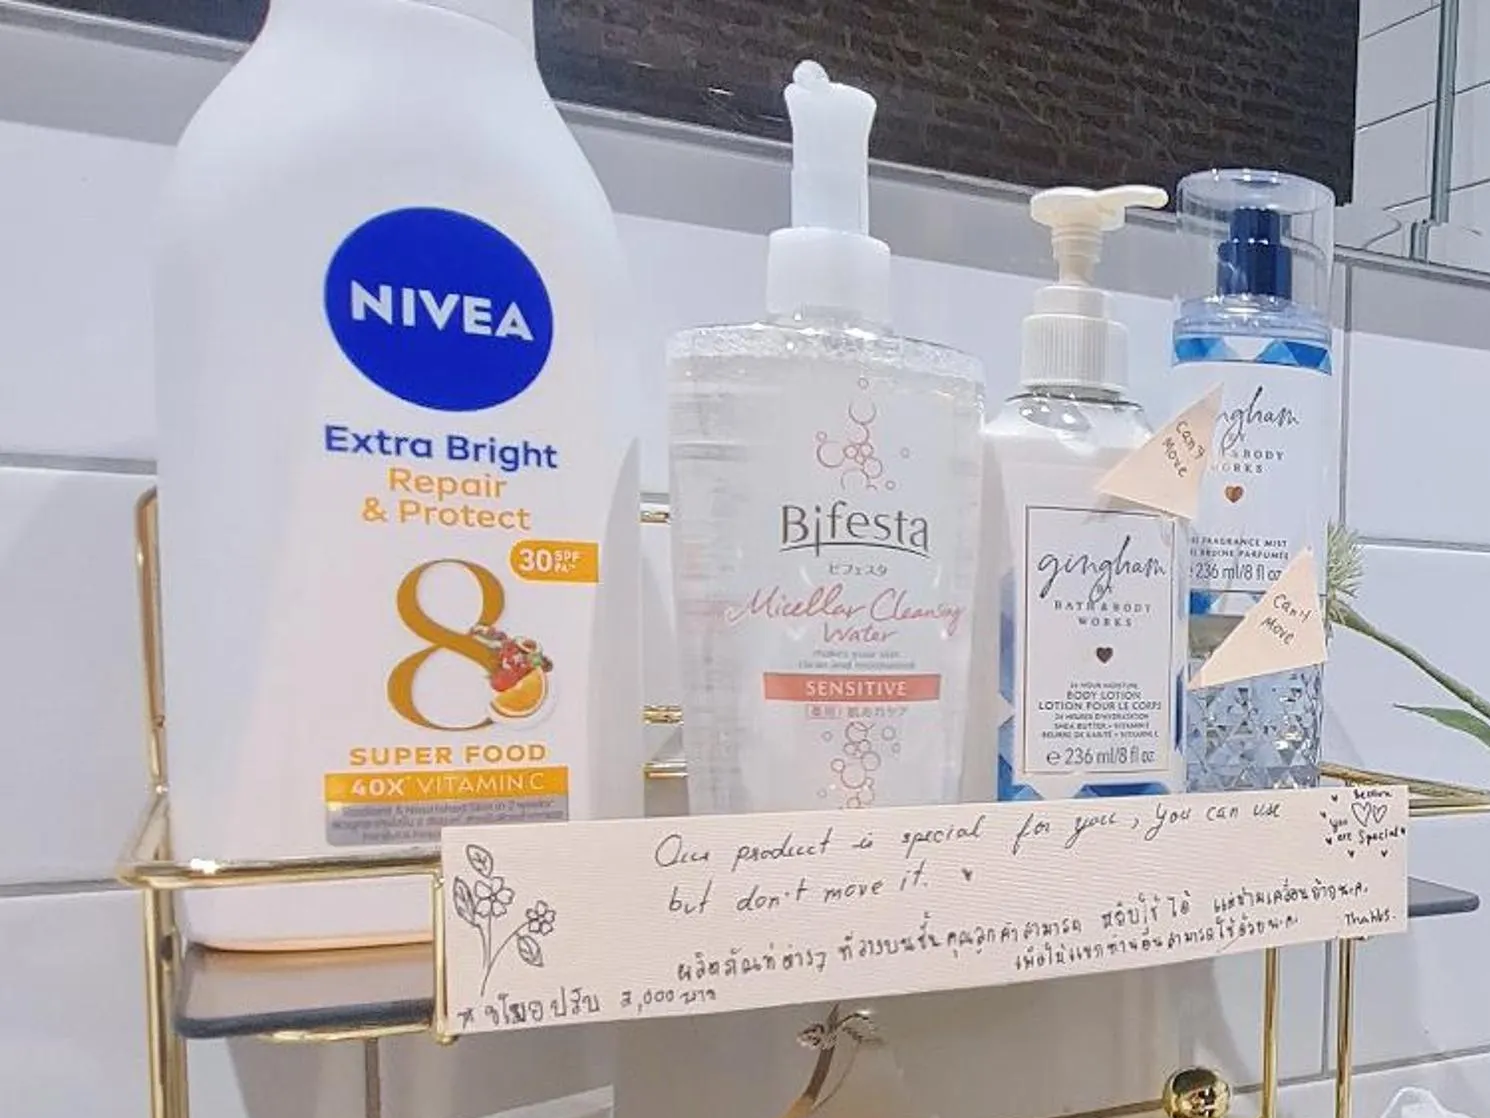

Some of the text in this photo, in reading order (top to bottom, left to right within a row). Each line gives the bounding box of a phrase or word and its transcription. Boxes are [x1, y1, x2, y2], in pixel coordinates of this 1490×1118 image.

[351, 280, 534, 341] NIVEA
[324, 425, 558, 473] Extra Bright
[1243, 449, 1284, 460] BODY
[388, 467, 507, 502] Repair
[362, 497, 532, 530] & Protect
[780, 501, 930, 556] Bifesta
[519, 548, 581, 573] 30 SPF
[828, 563, 888, 577] ビフェスタ
[1036, 535, 1166, 603] gingham
[1195, 562, 1219, 580] 236
[726, 584, 866, 623] Micellar
[1054, 600, 1094, 612] BATH
[1113, 603, 1152, 613] BODY
[825, 623, 899, 644] Water
[1078, 617, 1133, 627] WORKS
[386, 557, 510, 732] 8
[805, 680, 907, 697] SENSITIVE
[1066, 691, 1142, 700] BODY LOTION
[1038, 701, 1083, 711] LOTION
[1086, 701, 1115, 710] POUR
[1118, 701, 1128, 710] LE
[349, 744, 546, 767] SUPER FOOD
[1064, 747, 1094, 765] 236
[351, 773, 544, 797] 40X VITAMIN C
[1328, 817, 1348, 834] you
[655, 834, 709, 867] Our
[731, 827, 832, 872] product
[852, 833, 873, 849] is
[901, 815, 986, 860] special
[1013, 813, 1050, 856] for
[1144, 803, 1191, 841] you
[1206, 807, 1239, 822] can
[1253, 803, 1282, 817] use
[669, 880, 711, 914] but
[824, 880, 884, 902] move
